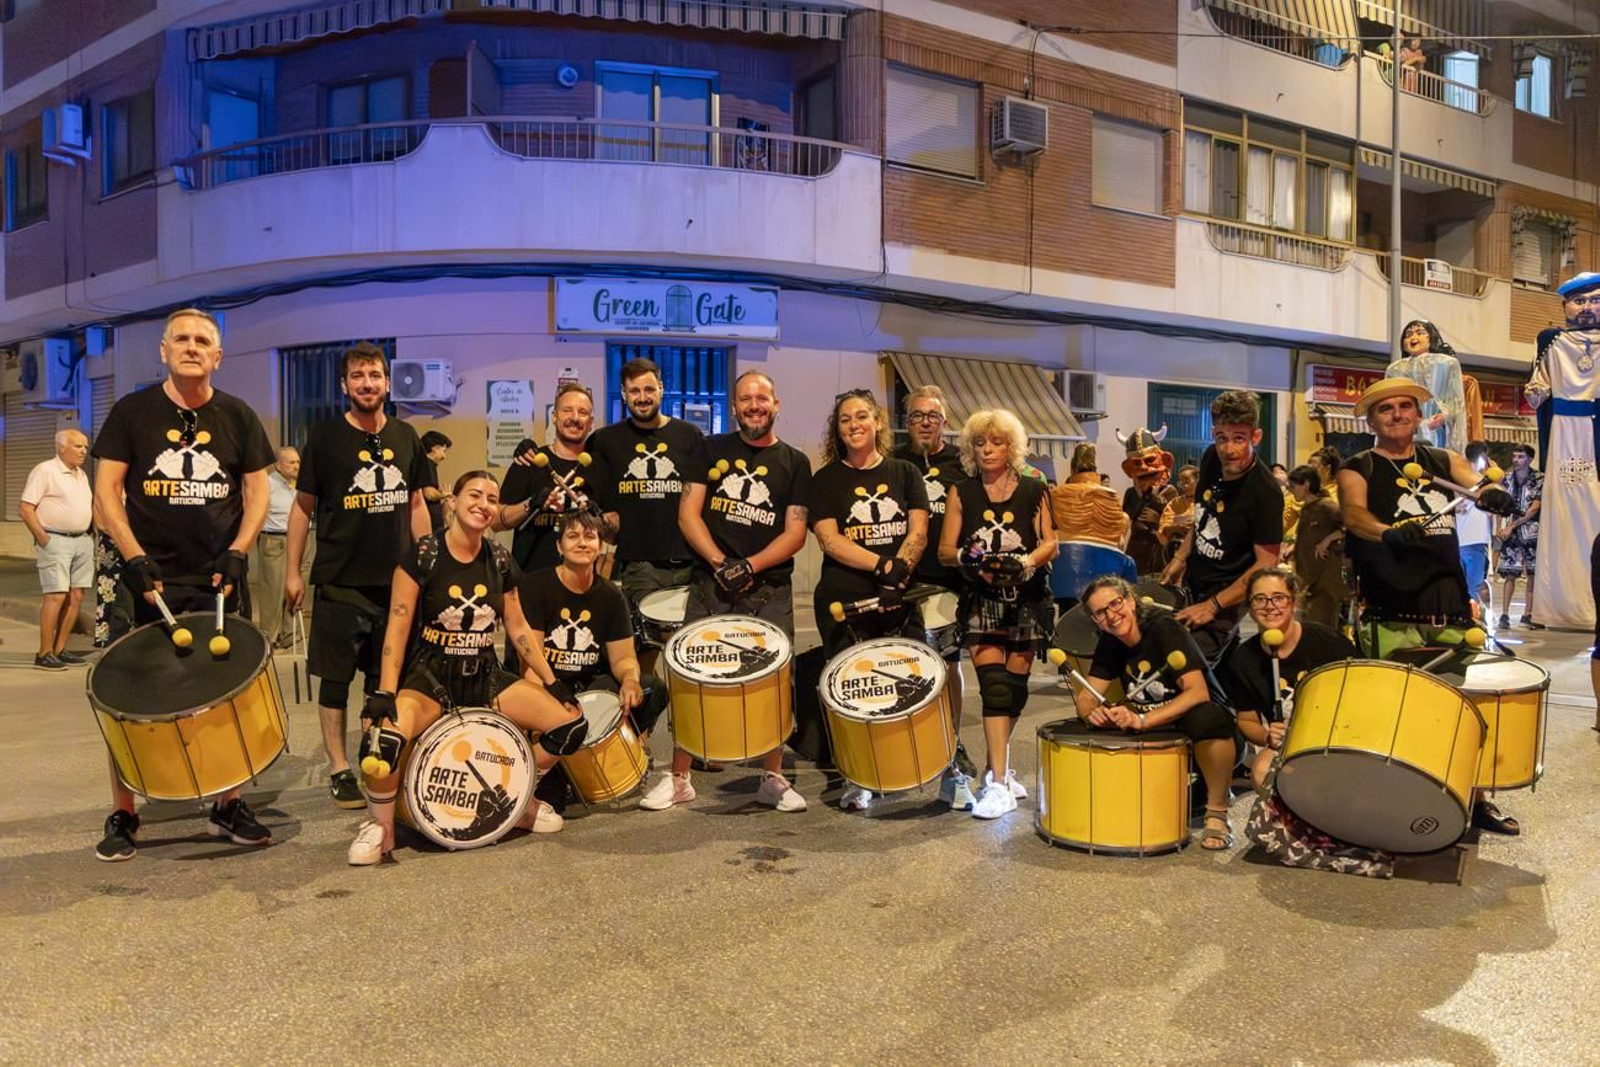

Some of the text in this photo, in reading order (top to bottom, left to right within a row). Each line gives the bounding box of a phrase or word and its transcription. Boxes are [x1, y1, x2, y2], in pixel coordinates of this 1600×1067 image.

[593, 288, 746, 326] Green Gate
[143, 480, 230, 498] ARTESAMBA
[619, 480, 683, 493] ARTESAMBA
[711, 496, 776, 526] ARTESAMBA
[421, 626, 493, 648] ARTESAMB
[686, 645, 724, 654] ARTE
[685, 653, 738, 664] SAMBA
[841, 675, 878, 690] ARTE
[841, 684, 894, 701] SAMBA
[475, 751, 515, 767] BATUCADA
[429, 767, 469, 788] ARTE
[425, 785, 478, 809] SAMBA
